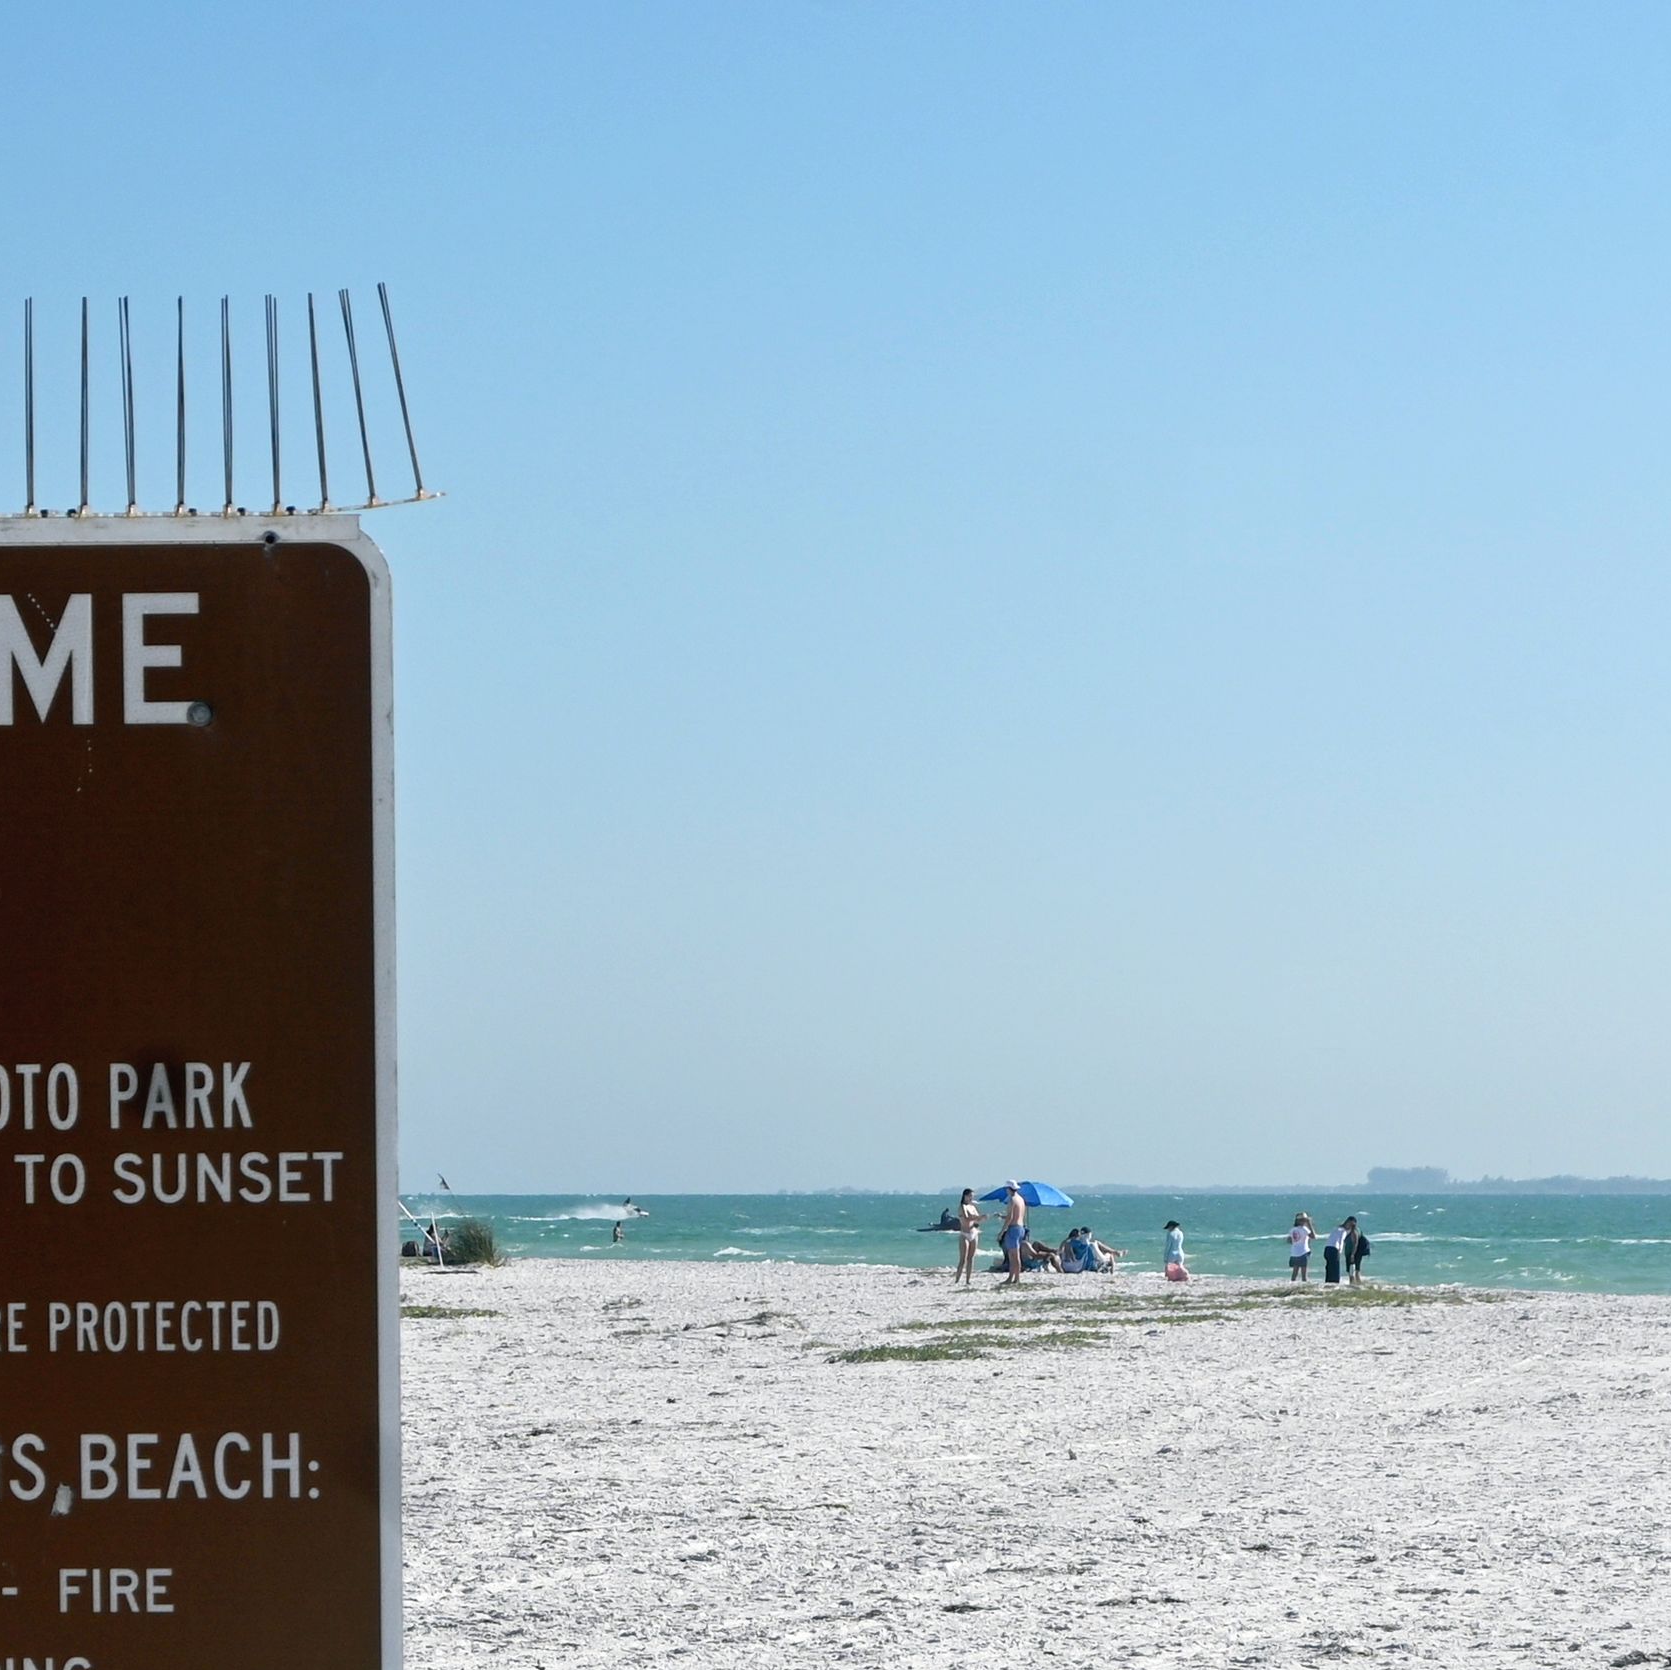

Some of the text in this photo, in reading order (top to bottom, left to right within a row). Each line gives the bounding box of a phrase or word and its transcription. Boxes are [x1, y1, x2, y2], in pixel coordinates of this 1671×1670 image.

[110, 1062, 253, 1129] PARK
[14, 1153, 86, 1205] TO
[113, 1151, 343, 1204] SUNSET
[49, 1300, 280, 1352] PROTECTED
[80, 1432, 320, 1499] BEACH:
[59, 1568, 174, 1613] FIRE
